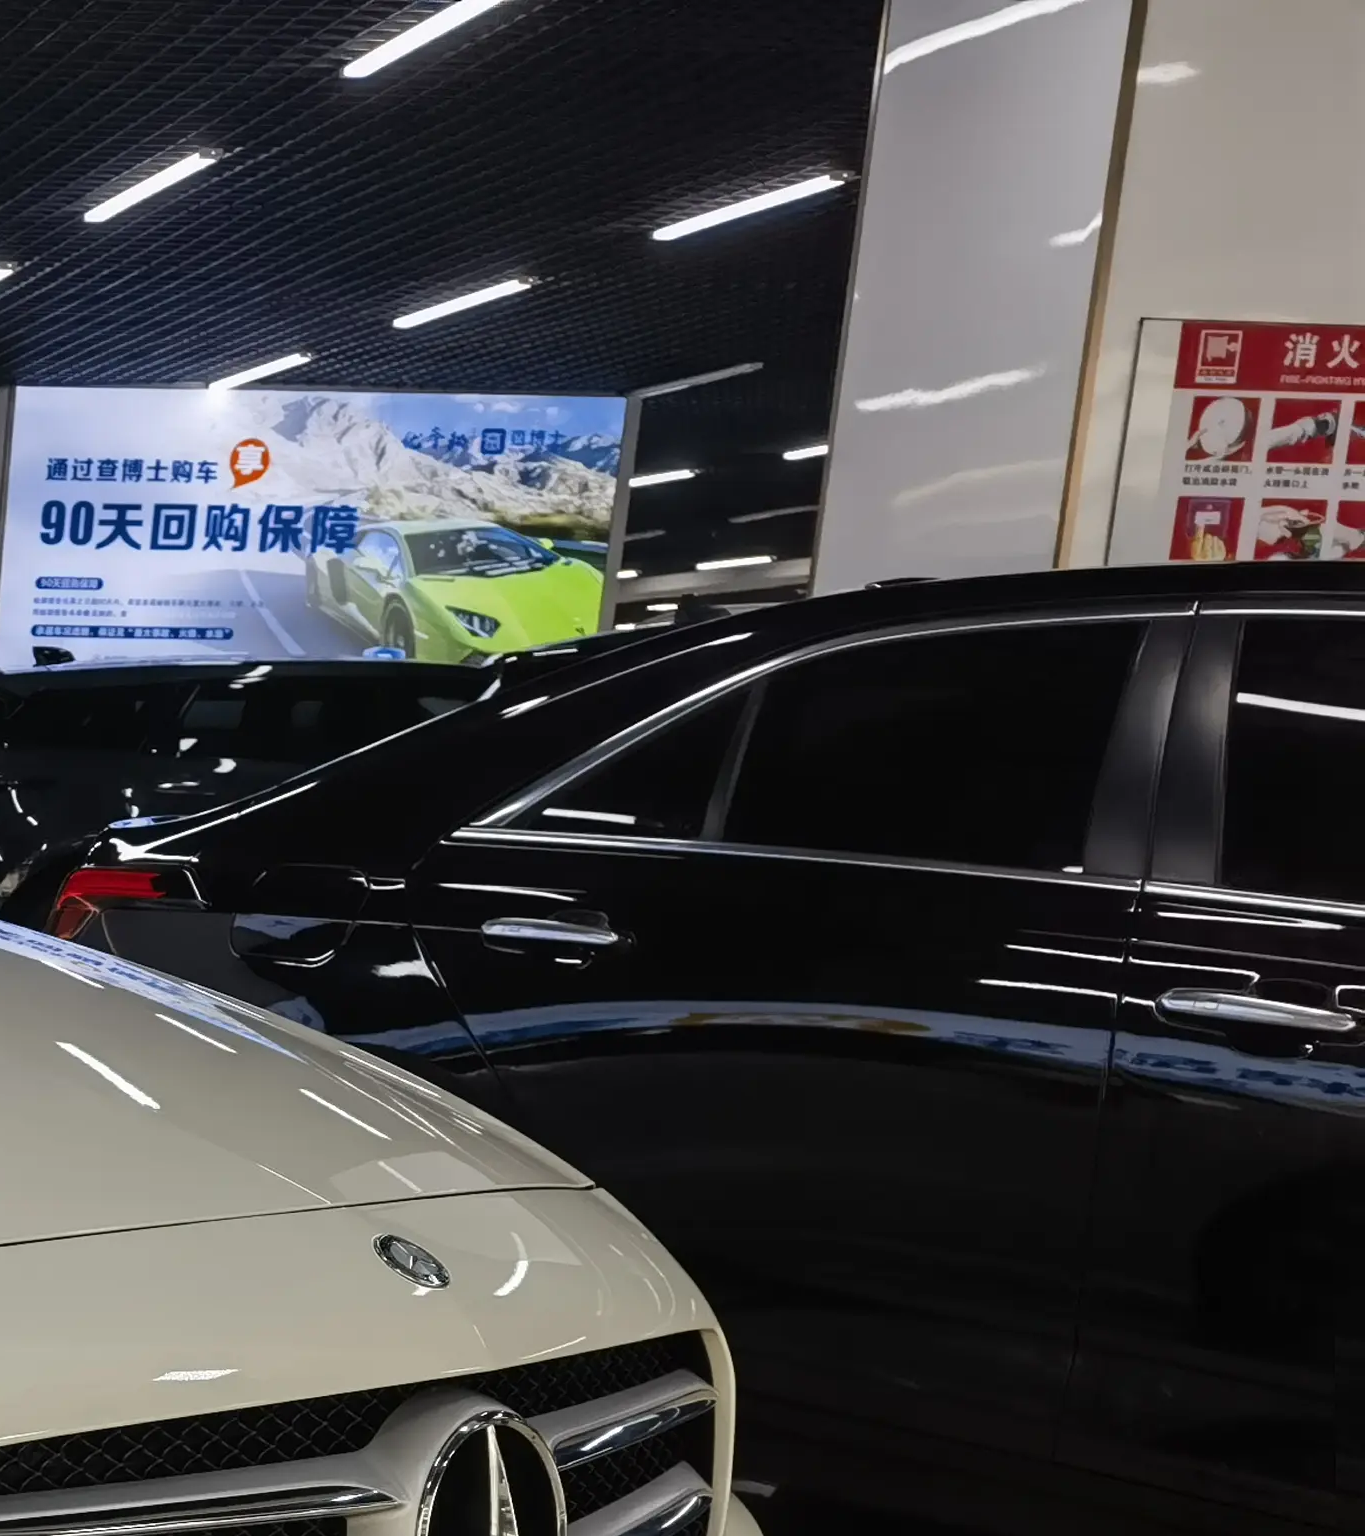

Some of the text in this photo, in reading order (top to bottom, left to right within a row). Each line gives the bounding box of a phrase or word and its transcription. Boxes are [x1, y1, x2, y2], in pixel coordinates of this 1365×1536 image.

[1283, 333, 1361, 368] 消火
[46, 458, 218, 483] 通过查博士购车
[40, 500, 360, 554] 90天回购保障
